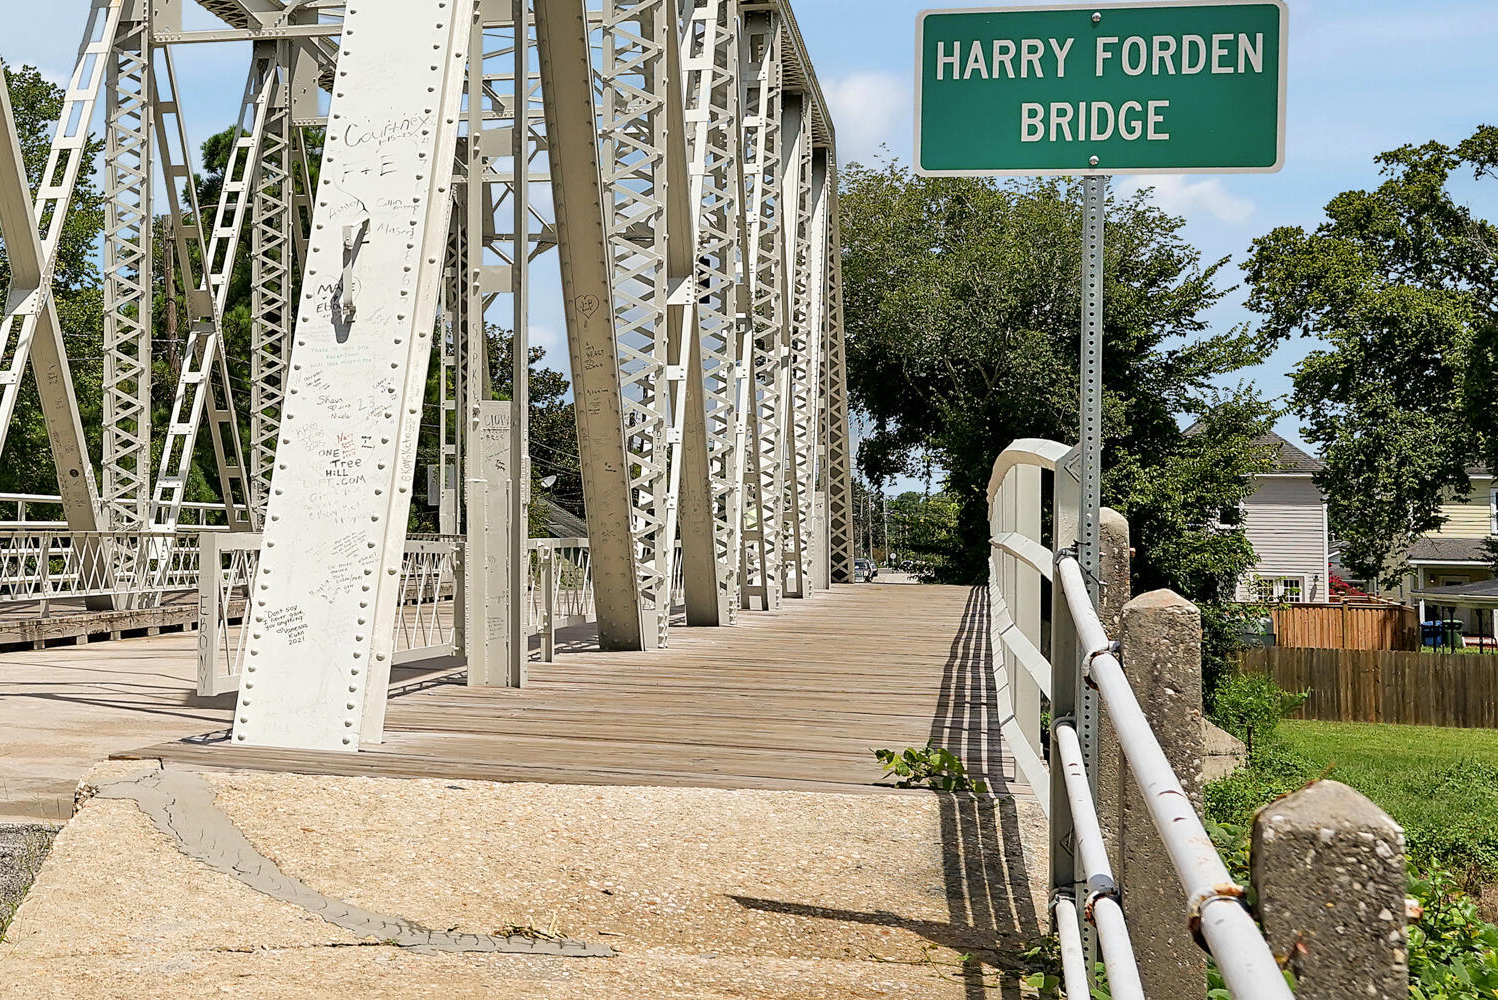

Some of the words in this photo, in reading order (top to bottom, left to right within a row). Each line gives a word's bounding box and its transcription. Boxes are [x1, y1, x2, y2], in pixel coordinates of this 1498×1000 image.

[936, 38, 1075, 81] HARRY
[1095, 32, 1264, 77] FORDEN
[1020, 99, 1170, 142] BRIDGE
[318, 449, 341, 458] ONE
[330, 458, 363, 468] Tree
